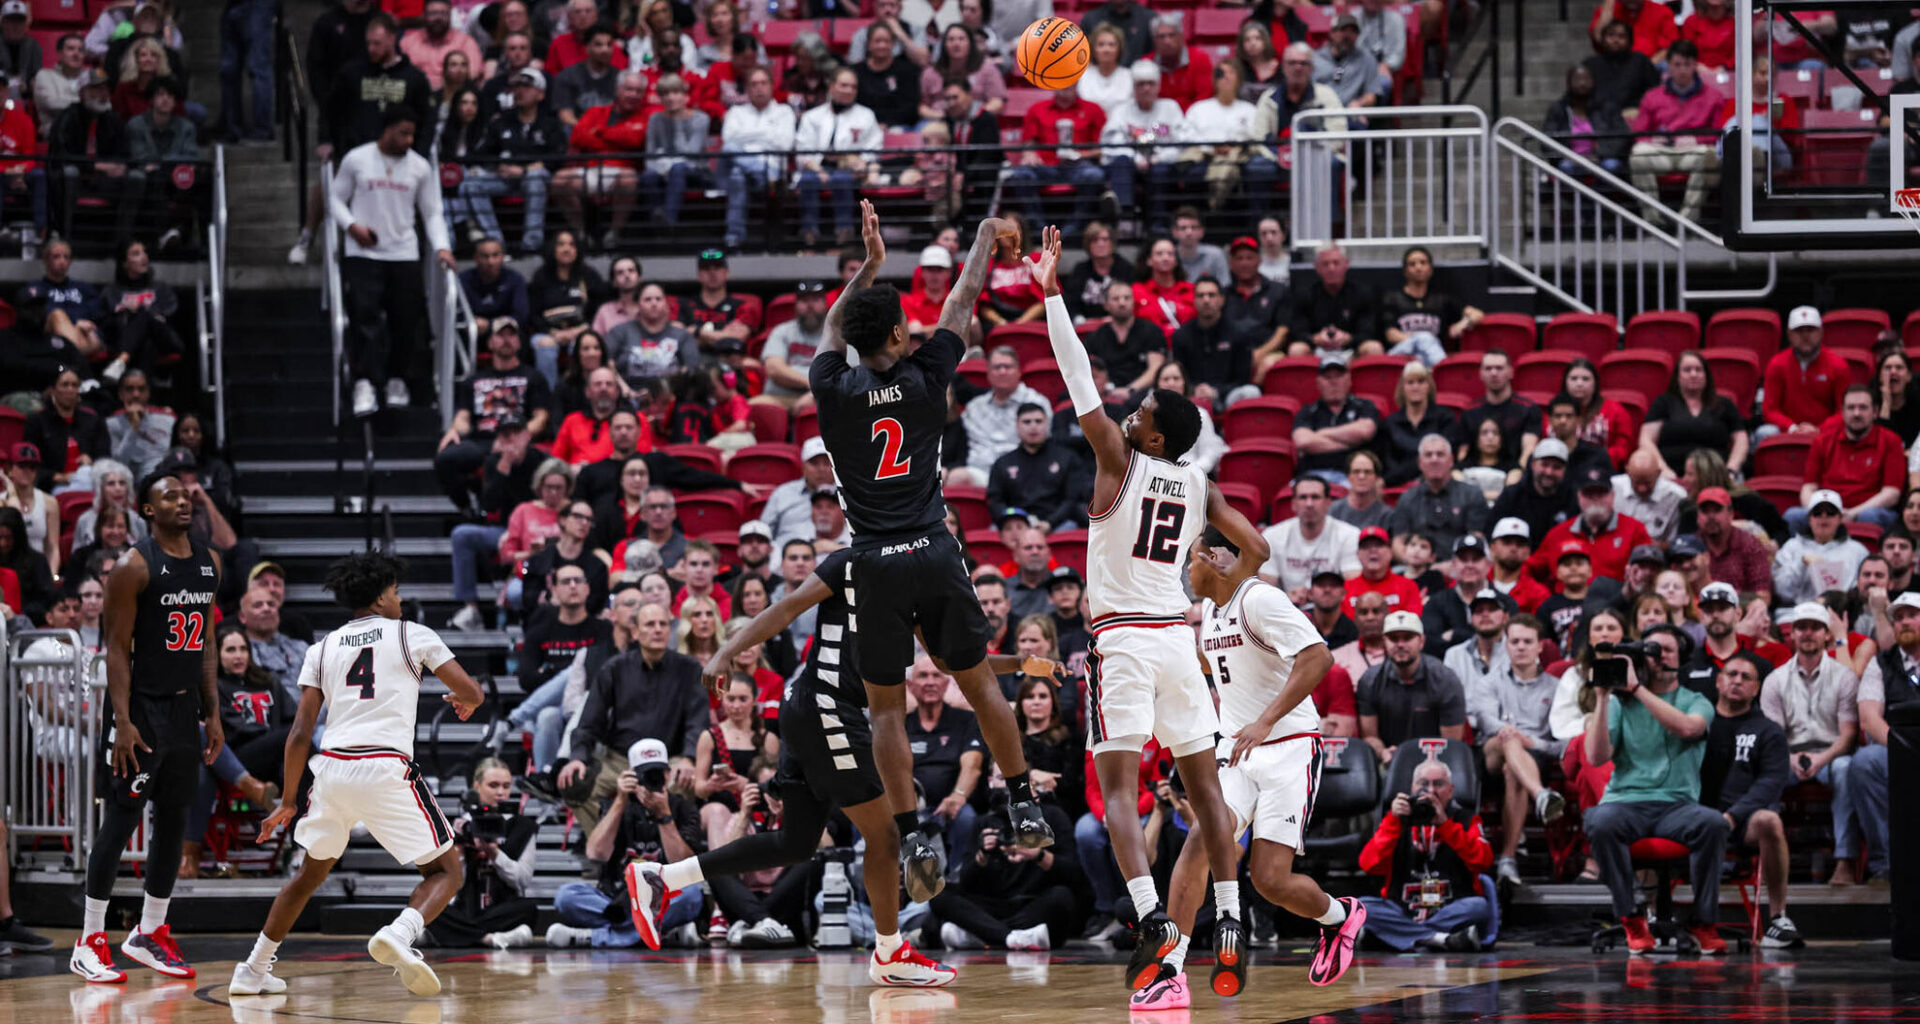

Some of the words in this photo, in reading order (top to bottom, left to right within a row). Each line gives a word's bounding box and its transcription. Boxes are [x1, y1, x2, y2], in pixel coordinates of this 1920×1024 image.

[1047, 23, 1081, 53] Wilson
[868, 385, 902, 407] JAMES
[871, 417, 911, 480] 2
[1148, 476, 1186, 498] ATWELL
[1131, 496, 1186, 564] 12
[880, 536, 930, 557] BEARCATS
[160, 588, 214, 606] CINCINNATI
[165, 611, 204, 651] 32
[339, 627, 383, 647] ANDERSON
[1213, 633, 1244, 650] RAIDERS
[345, 646, 375, 699] 4
[1217, 655, 1231, 685] 5
